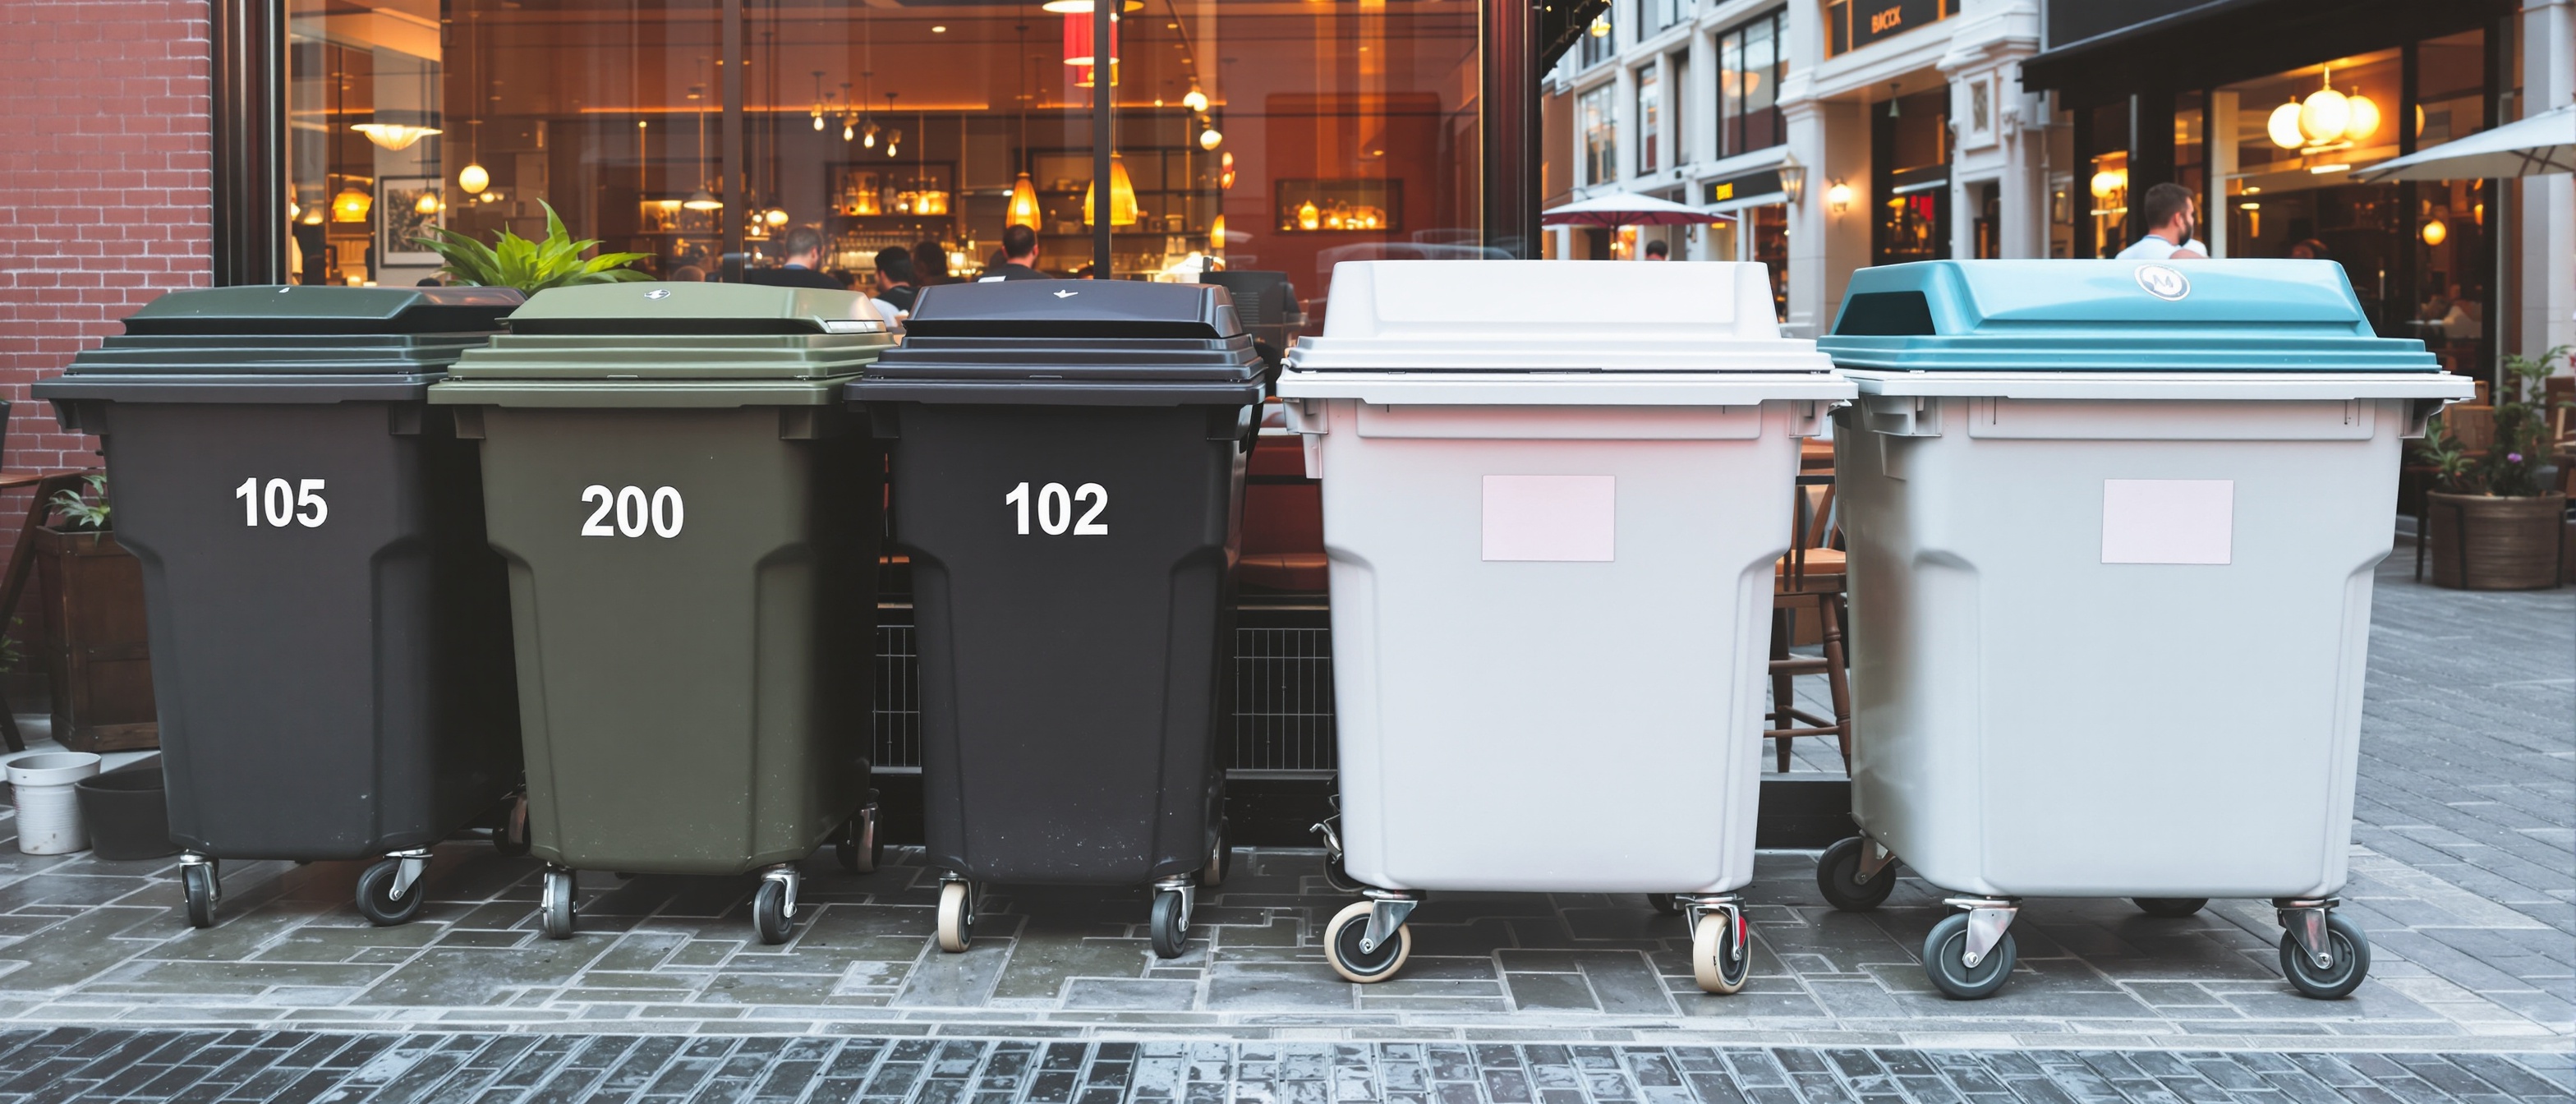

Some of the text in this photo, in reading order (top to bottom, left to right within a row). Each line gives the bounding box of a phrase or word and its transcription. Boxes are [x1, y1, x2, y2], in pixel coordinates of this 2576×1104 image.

[236, 477, 328, 528] 105
[581, 485, 684, 539] 200
[1005, 481, 1108, 536] 102
